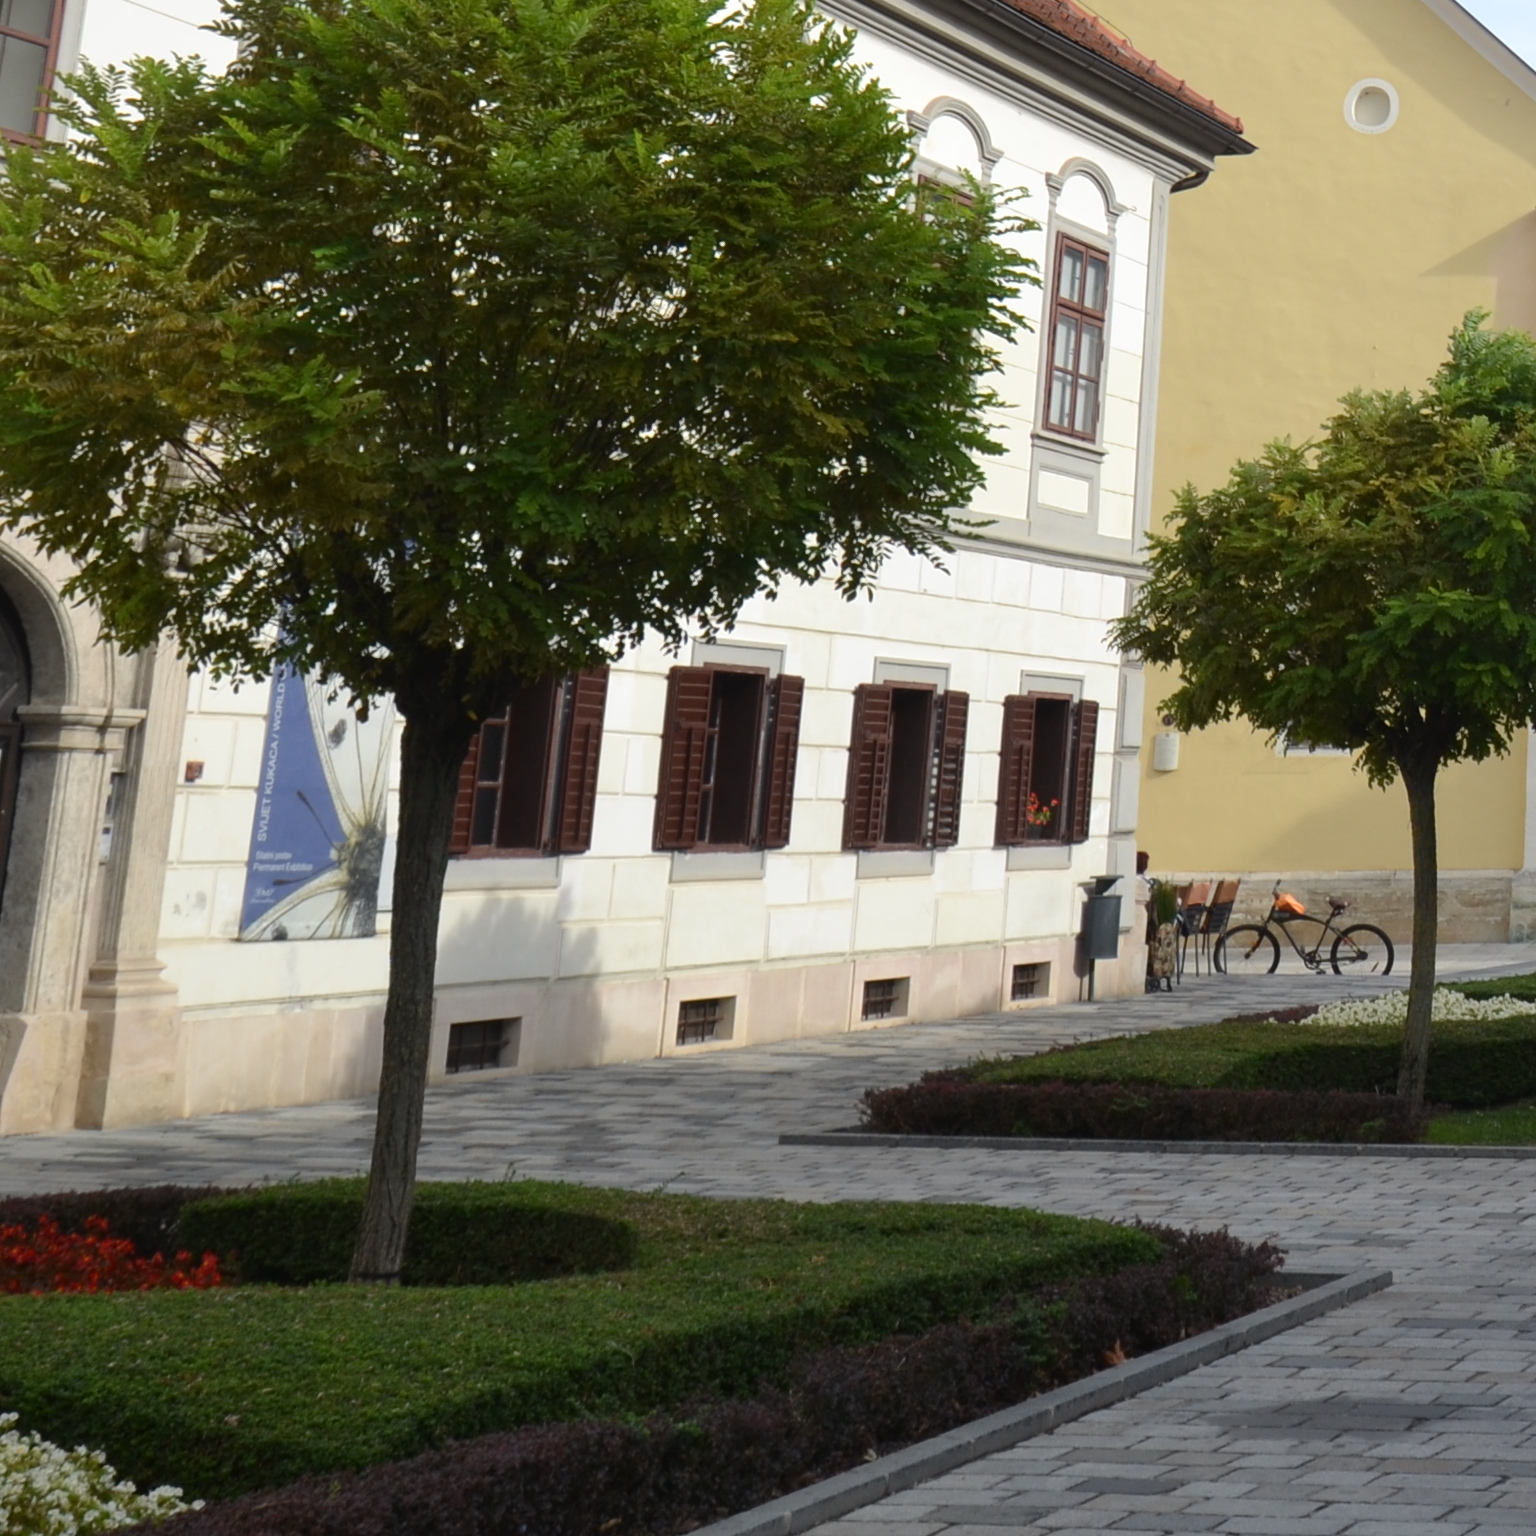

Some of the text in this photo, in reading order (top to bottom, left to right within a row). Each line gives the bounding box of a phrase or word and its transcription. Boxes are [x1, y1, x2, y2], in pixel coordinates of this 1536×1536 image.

[273, 682, 286, 732] WORLD
[264, 740, 279, 794] KUKACA
[257, 797, 272, 842] SVIJET
